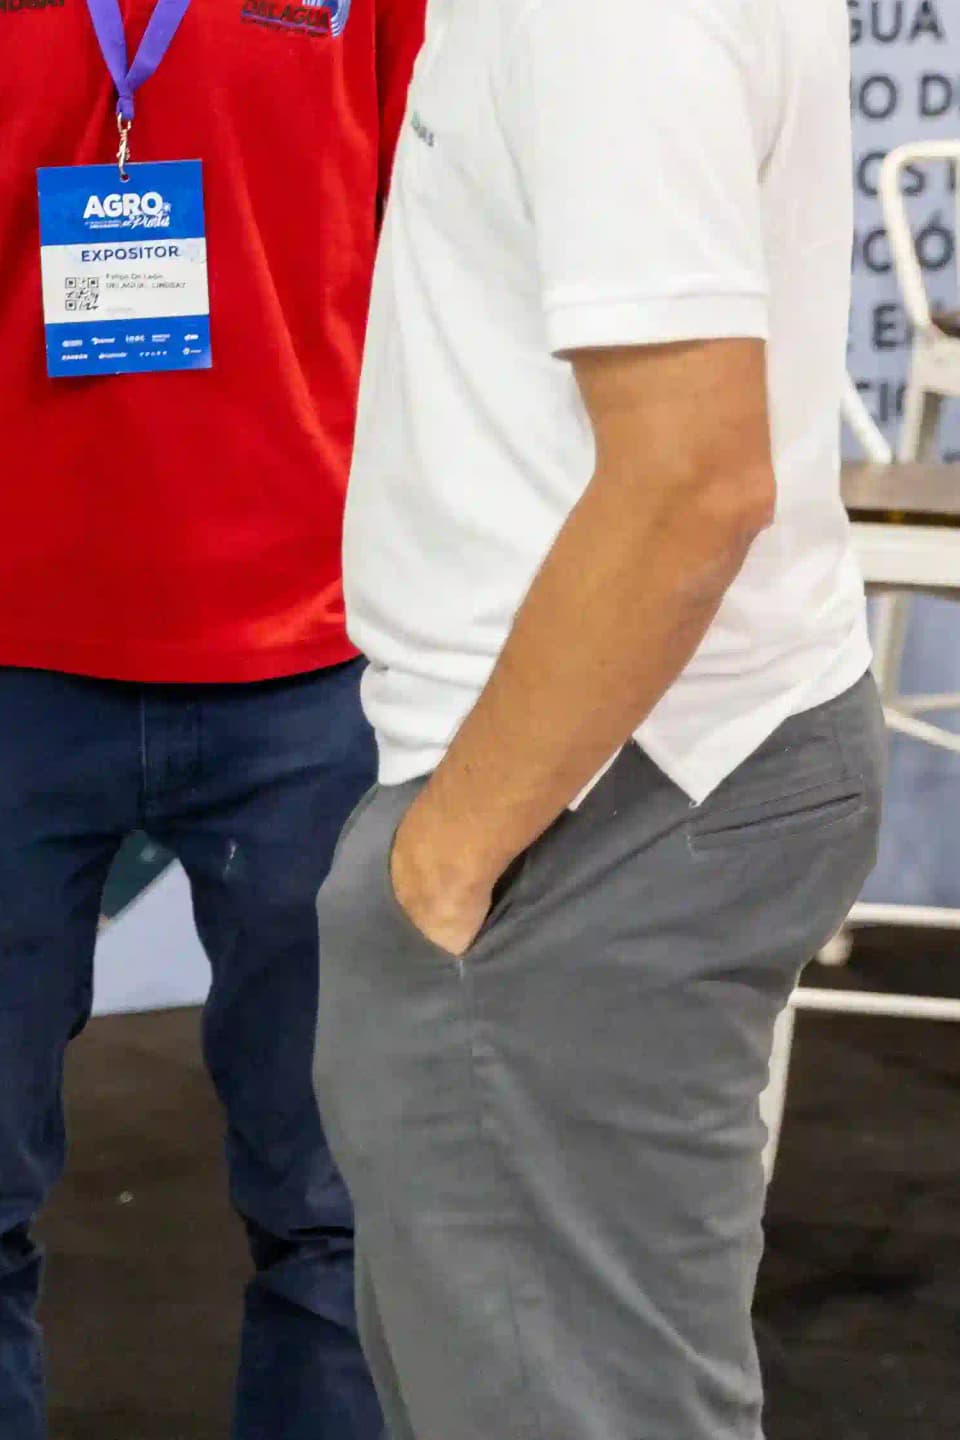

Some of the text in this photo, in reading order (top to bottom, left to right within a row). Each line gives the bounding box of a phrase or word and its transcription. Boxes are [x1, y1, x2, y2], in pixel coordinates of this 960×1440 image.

[851, 73, 960, 120] O D
[83, 191, 163, 219] AGRO
[81, 246, 179, 263] EXPOSITOR
